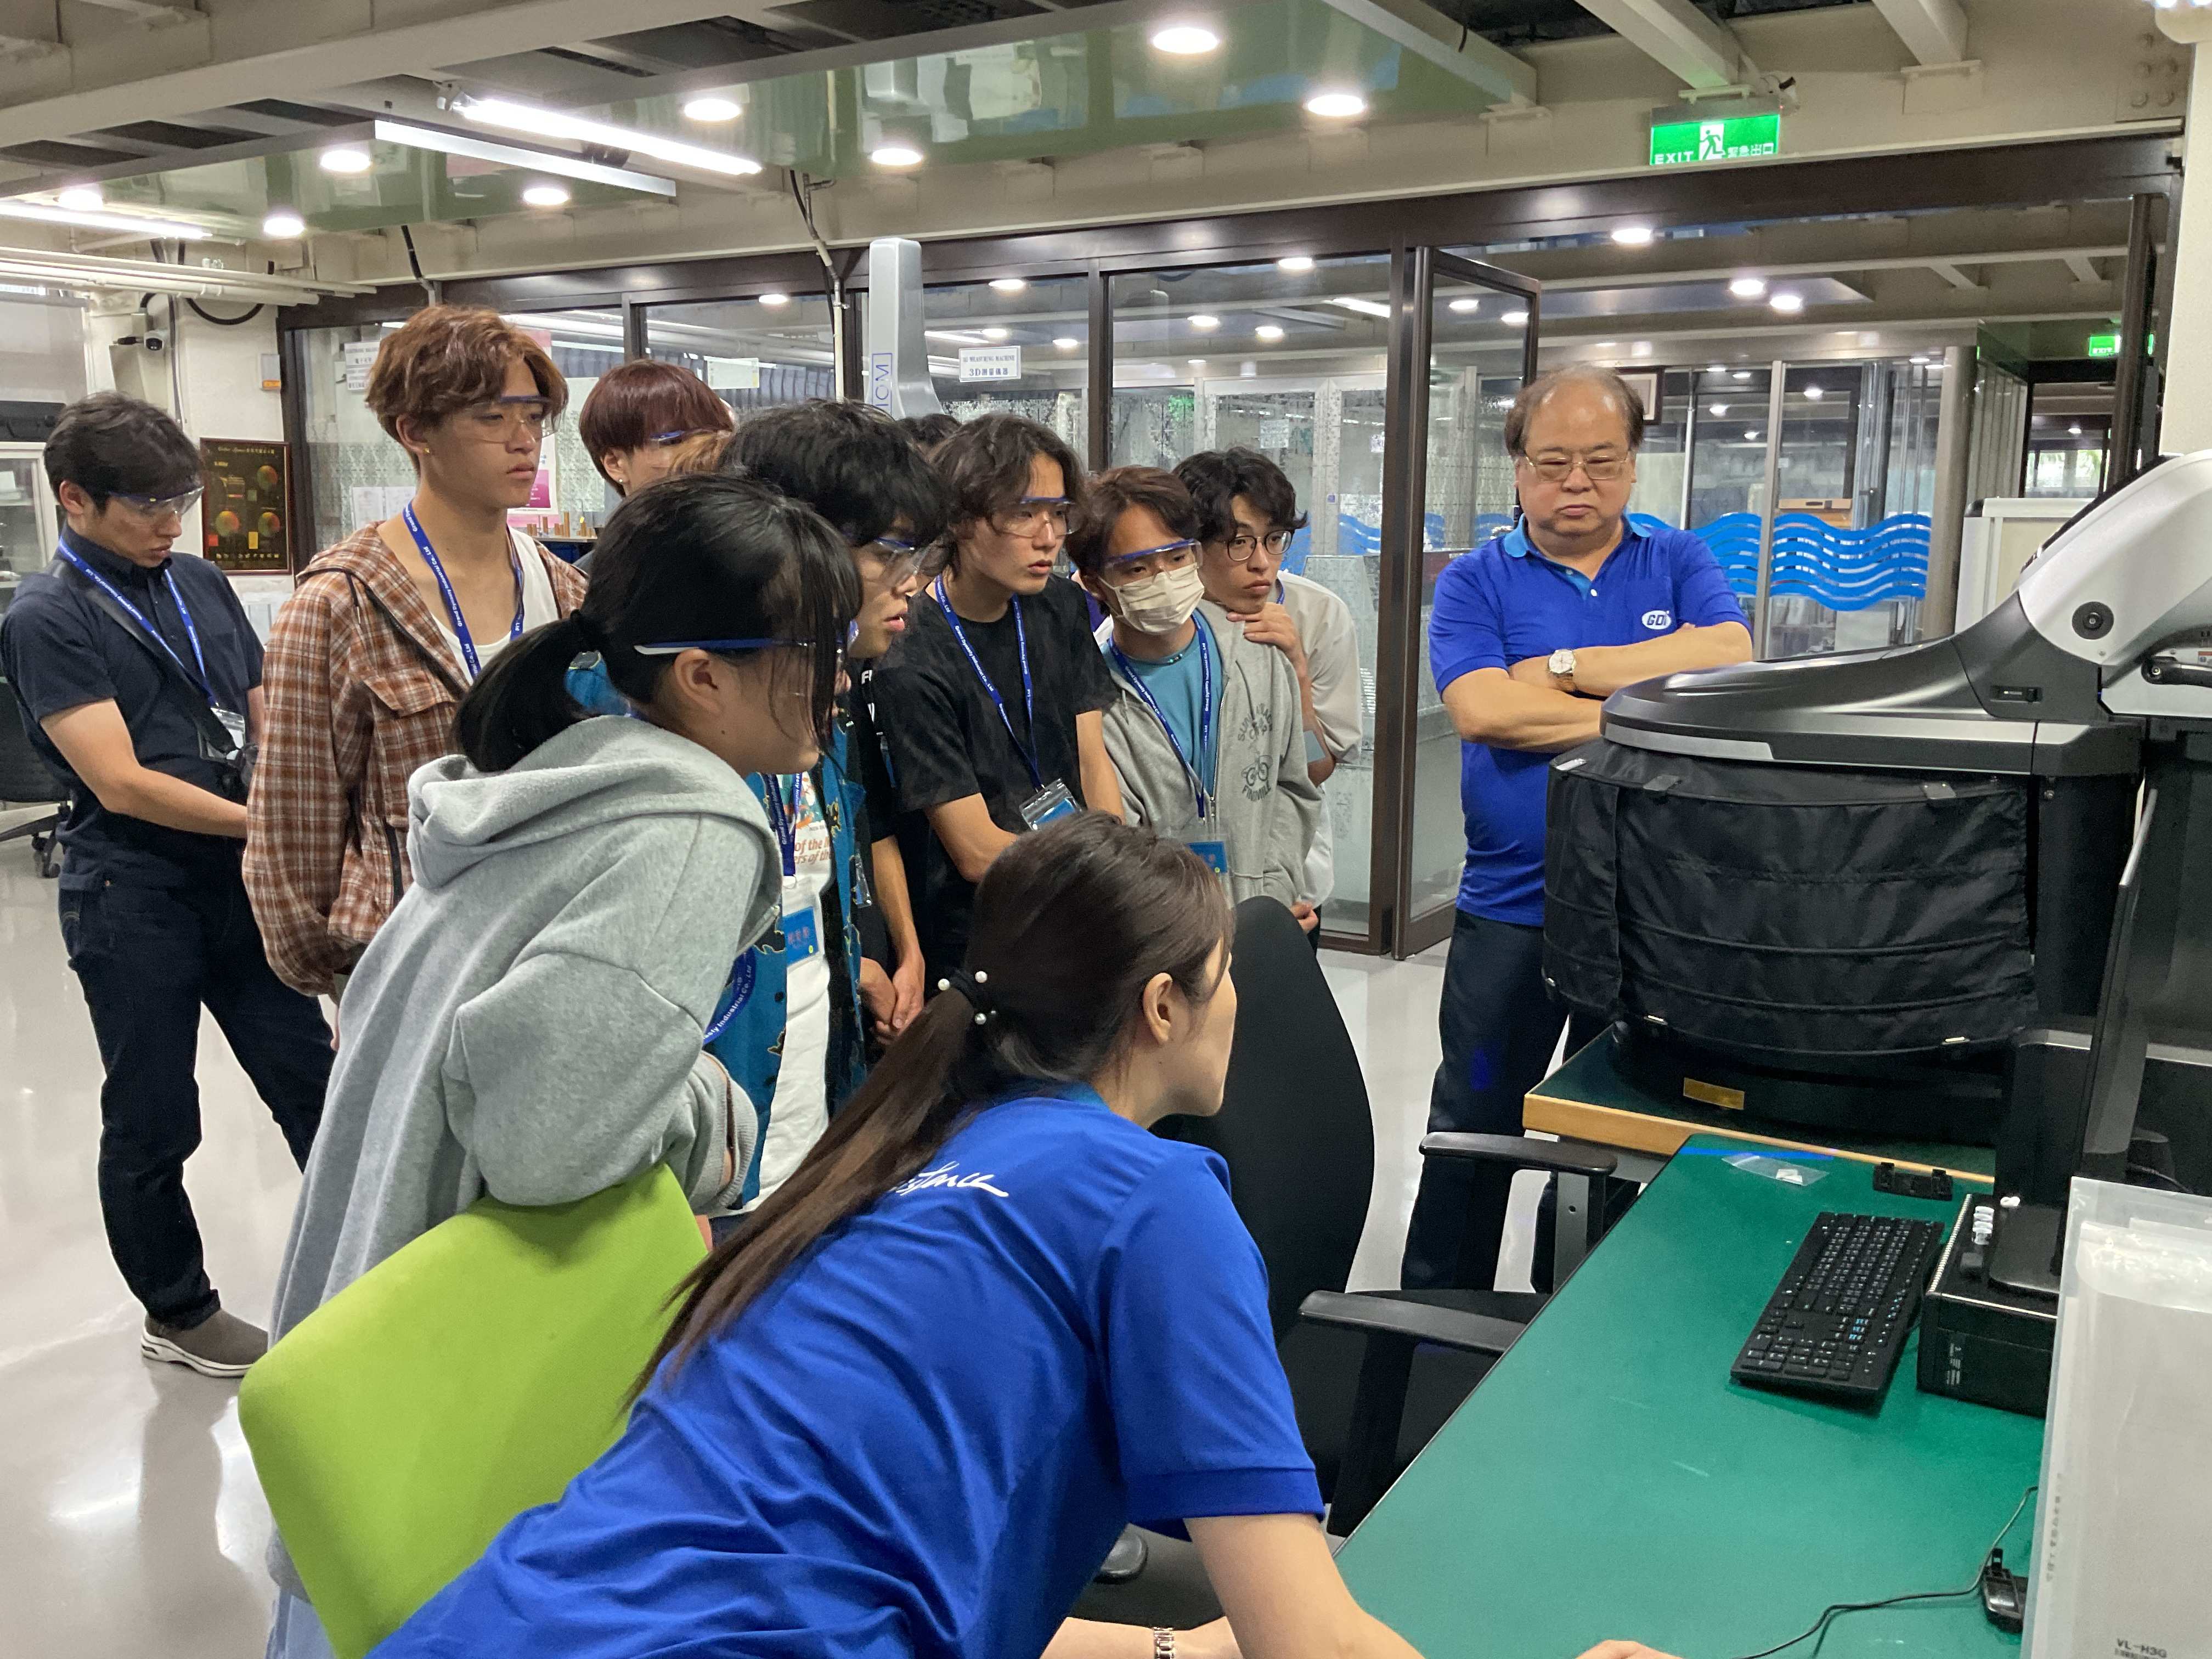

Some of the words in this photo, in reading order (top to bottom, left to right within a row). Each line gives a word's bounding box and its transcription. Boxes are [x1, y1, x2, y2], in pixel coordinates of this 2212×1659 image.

[1655, 151, 1694, 165] EXIT
[1728, 143, 1774, 159] 緊急出口
[875, 364, 889, 406] IOM
[433, 565, 449, 589] Industrial
[447, 589, 457, 611] Dynasty
[454, 610, 462, 627] Grand
[794, 839, 808, 855] of
[808, 838, 823, 851] the
[716, 994, 744, 1028] Industrial
